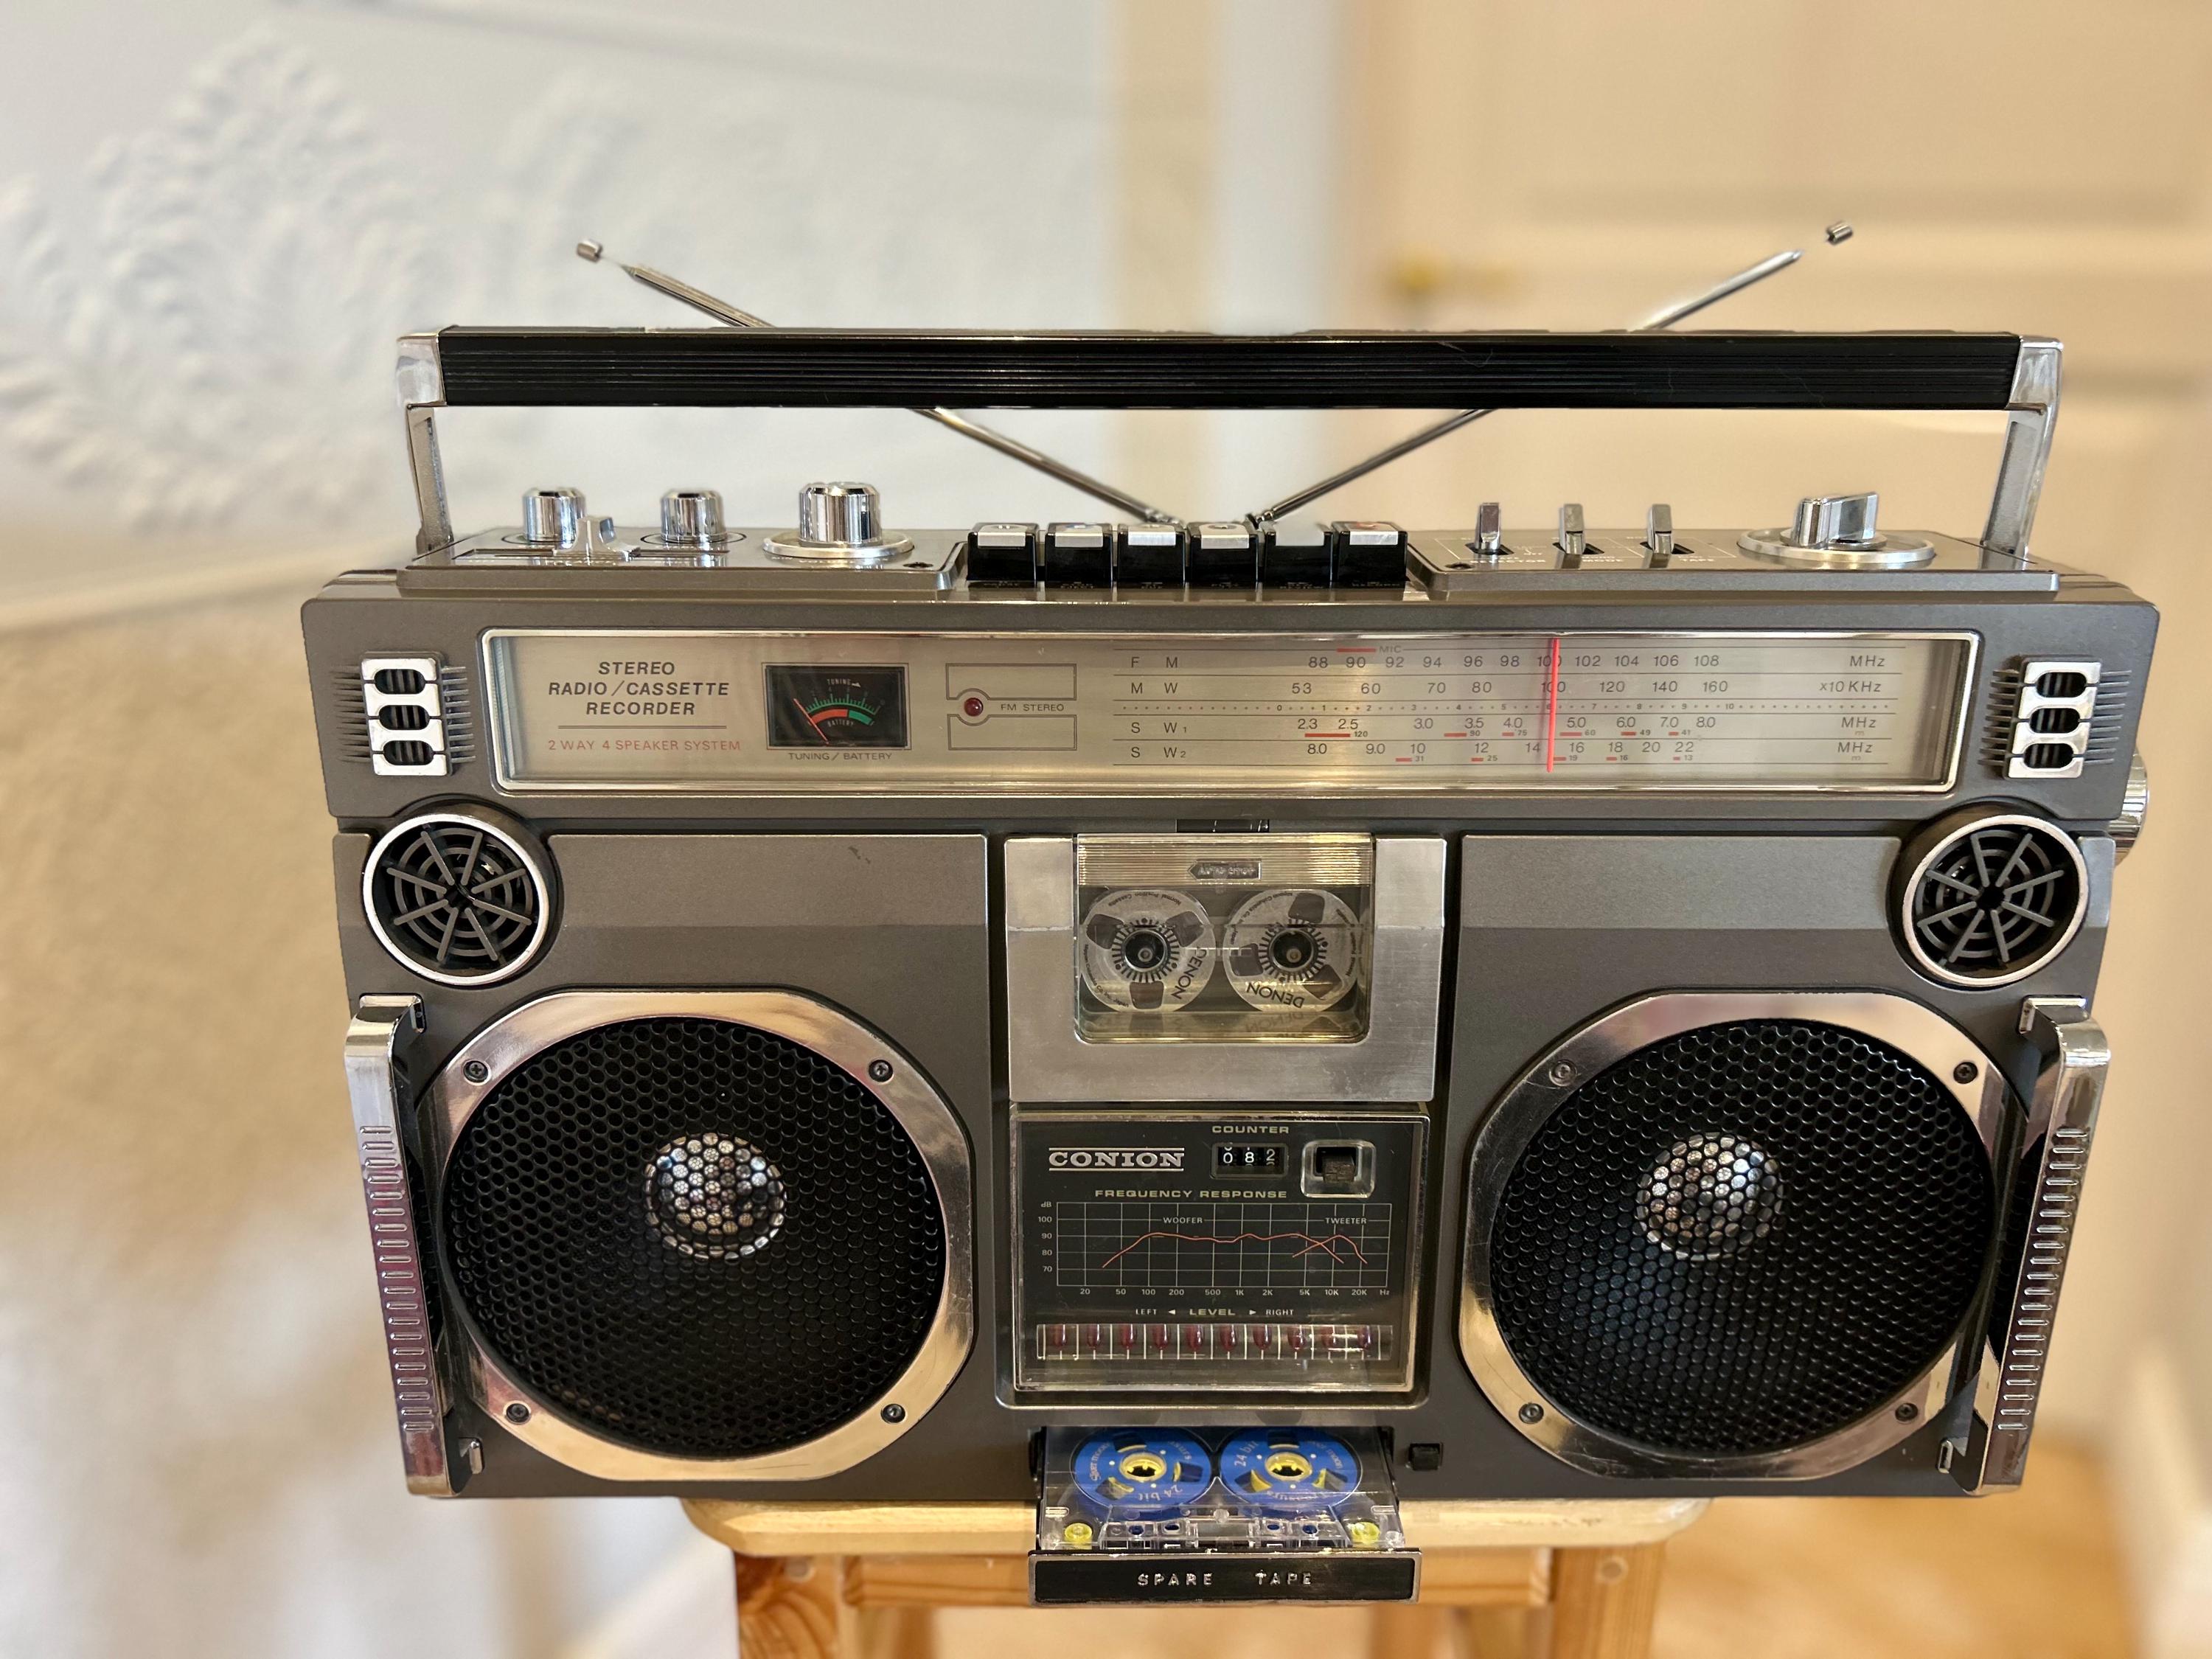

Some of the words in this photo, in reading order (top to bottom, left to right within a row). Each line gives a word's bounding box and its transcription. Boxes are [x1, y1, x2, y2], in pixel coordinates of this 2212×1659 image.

[1379, 645, 1402, 654] MIC
[598, 661, 675, 675] STEREO
[1308, 656, 1329, 669] 88
[1346, 656, 1366, 669] 90
[1385, 655, 1405, 668] 92
[1422, 655, 1442, 668] 94
[1464, 655, 1484, 668] 96
[1500, 655, 1520, 667] 98
[1574, 655, 1601, 667] 102
[1614, 655, 1639, 667] 104
[1653, 655, 1679, 667] 106
[1694, 655, 1719, 667] 108
[1849, 655, 1885, 667] MHz
[1292, 682, 1312, 695] 53
[1360, 683, 1381, 695] 60
[1427, 682, 1446, 694] 70
[1472, 681, 1492, 694] 80
[1599, 681, 1625, 693] 120
[1652, 681, 1677, 693] 140
[1703, 681, 1728, 693] 160
[585, 702, 695, 716] RECORDER
[1001, 703, 1017, 712] FM
[1023, 703, 1065, 712] STEREO
[1298, 718, 1318, 730] 2.3
[1338, 718, 1358, 730] 2.5
[1413, 718, 1433, 729] 3.0
[1464, 717, 1484, 729] 3.5
[1503, 717, 1523, 728] 4.0
[1567, 717, 1586, 728] 5.0
[1616, 717, 1636, 728] 6.0
[1660, 717, 1679, 728] 7.0
[1696, 717, 1716, 728] 8.0
[1841, 717, 1877, 728] MHz
[548, 740, 556, 751] 2
[560, 740, 594, 751] WAY
[602, 740, 611, 751] 4
[615, 740, 678, 751] SPEAKER
[684, 740, 741, 751] SYSTEM
[1307, 743, 1327, 755] 8.0
[1366, 743, 1385, 755] 9.0
[1411, 742, 1426, 754] 10
[1475, 742, 1489, 754] 12
[1526, 742, 1541, 754] 14
[1569, 742, 1585, 754] 16
[1609, 742, 1623, 754] 18
[1641, 742, 1660, 754] 20
[1674, 742, 1694, 754] 22
[1837, 742, 1873, 754] MHz
[1171, 946, 1207, 1000] DENON
[1246, 981, 1305, 1009] DENON
[1212, 1125, 1290, 1134] COUNTER
[1048, 1152, 1185, 1167] CONION
[1222, 1148, 1276, 1164] 082
[1199, 1191, 1287, 1199] RESPONSE
[1234, 1453, 1248, 1467] 24
[1138, 1492, 1161, 1501] bit
[1164, 1484, 1183, 1498] 24
[1138, 1572, 1212, 1586] SPARE
[1255, 1570, 1312, 1586] TAPE
